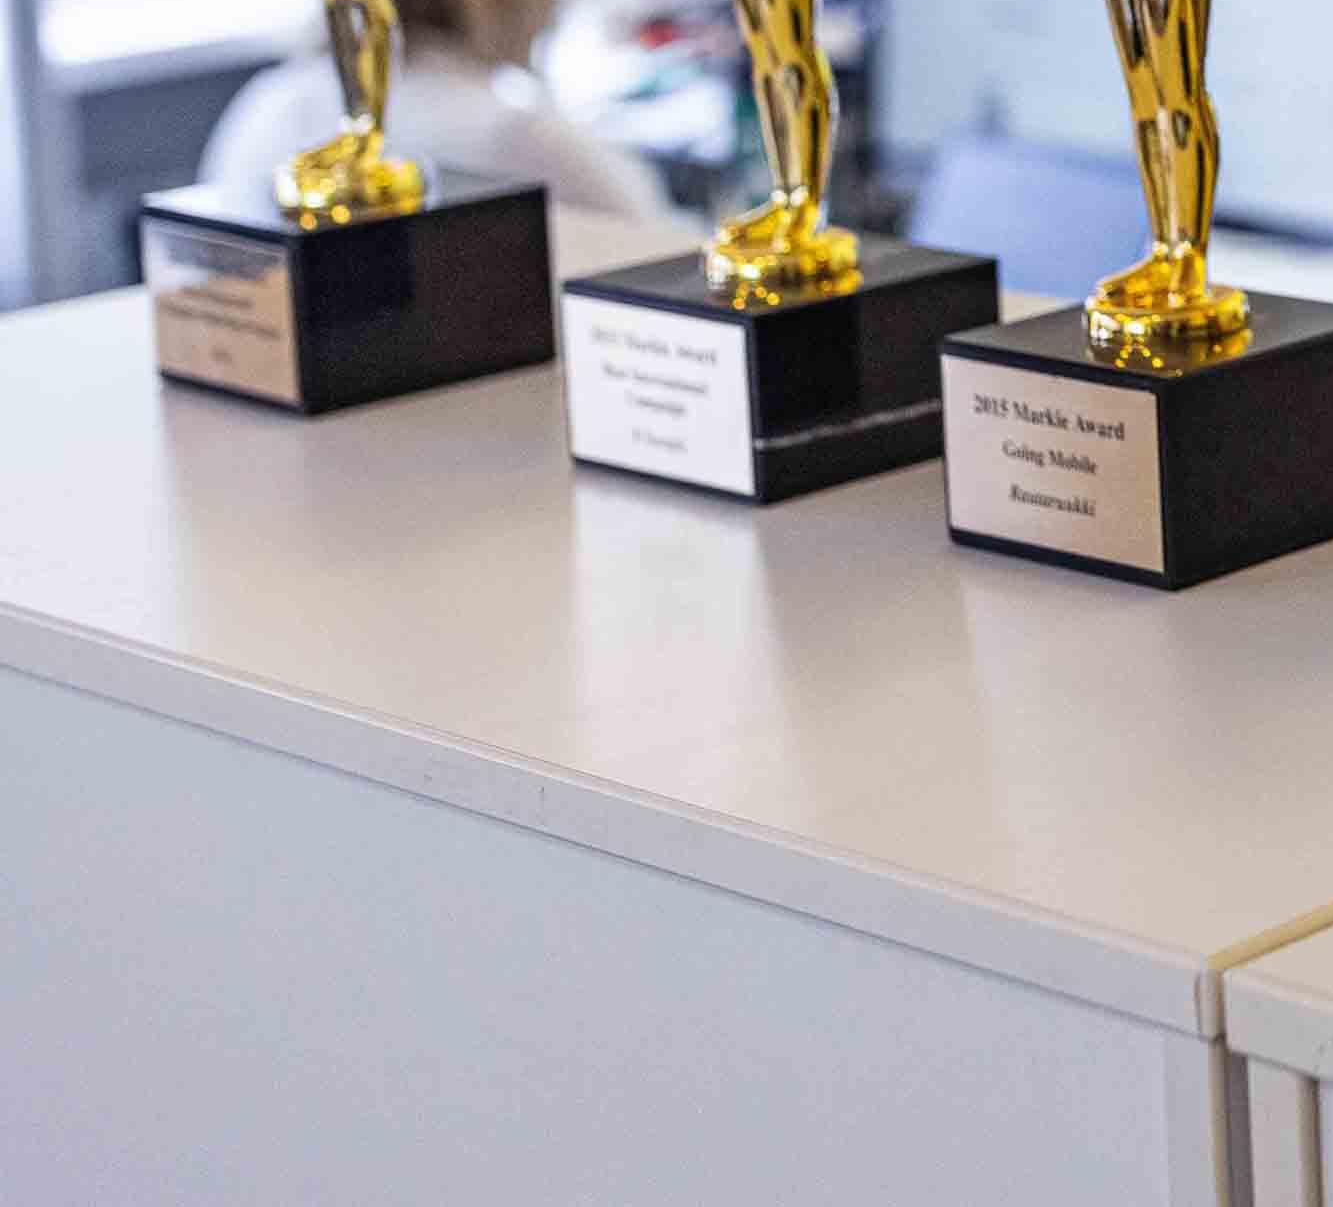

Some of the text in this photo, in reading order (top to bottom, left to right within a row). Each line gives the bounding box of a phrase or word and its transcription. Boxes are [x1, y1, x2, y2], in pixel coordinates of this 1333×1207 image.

[974, 395, 1125, 441] 2015 Markie Award
[1002, 439, 1097, 474] Going Mobile
